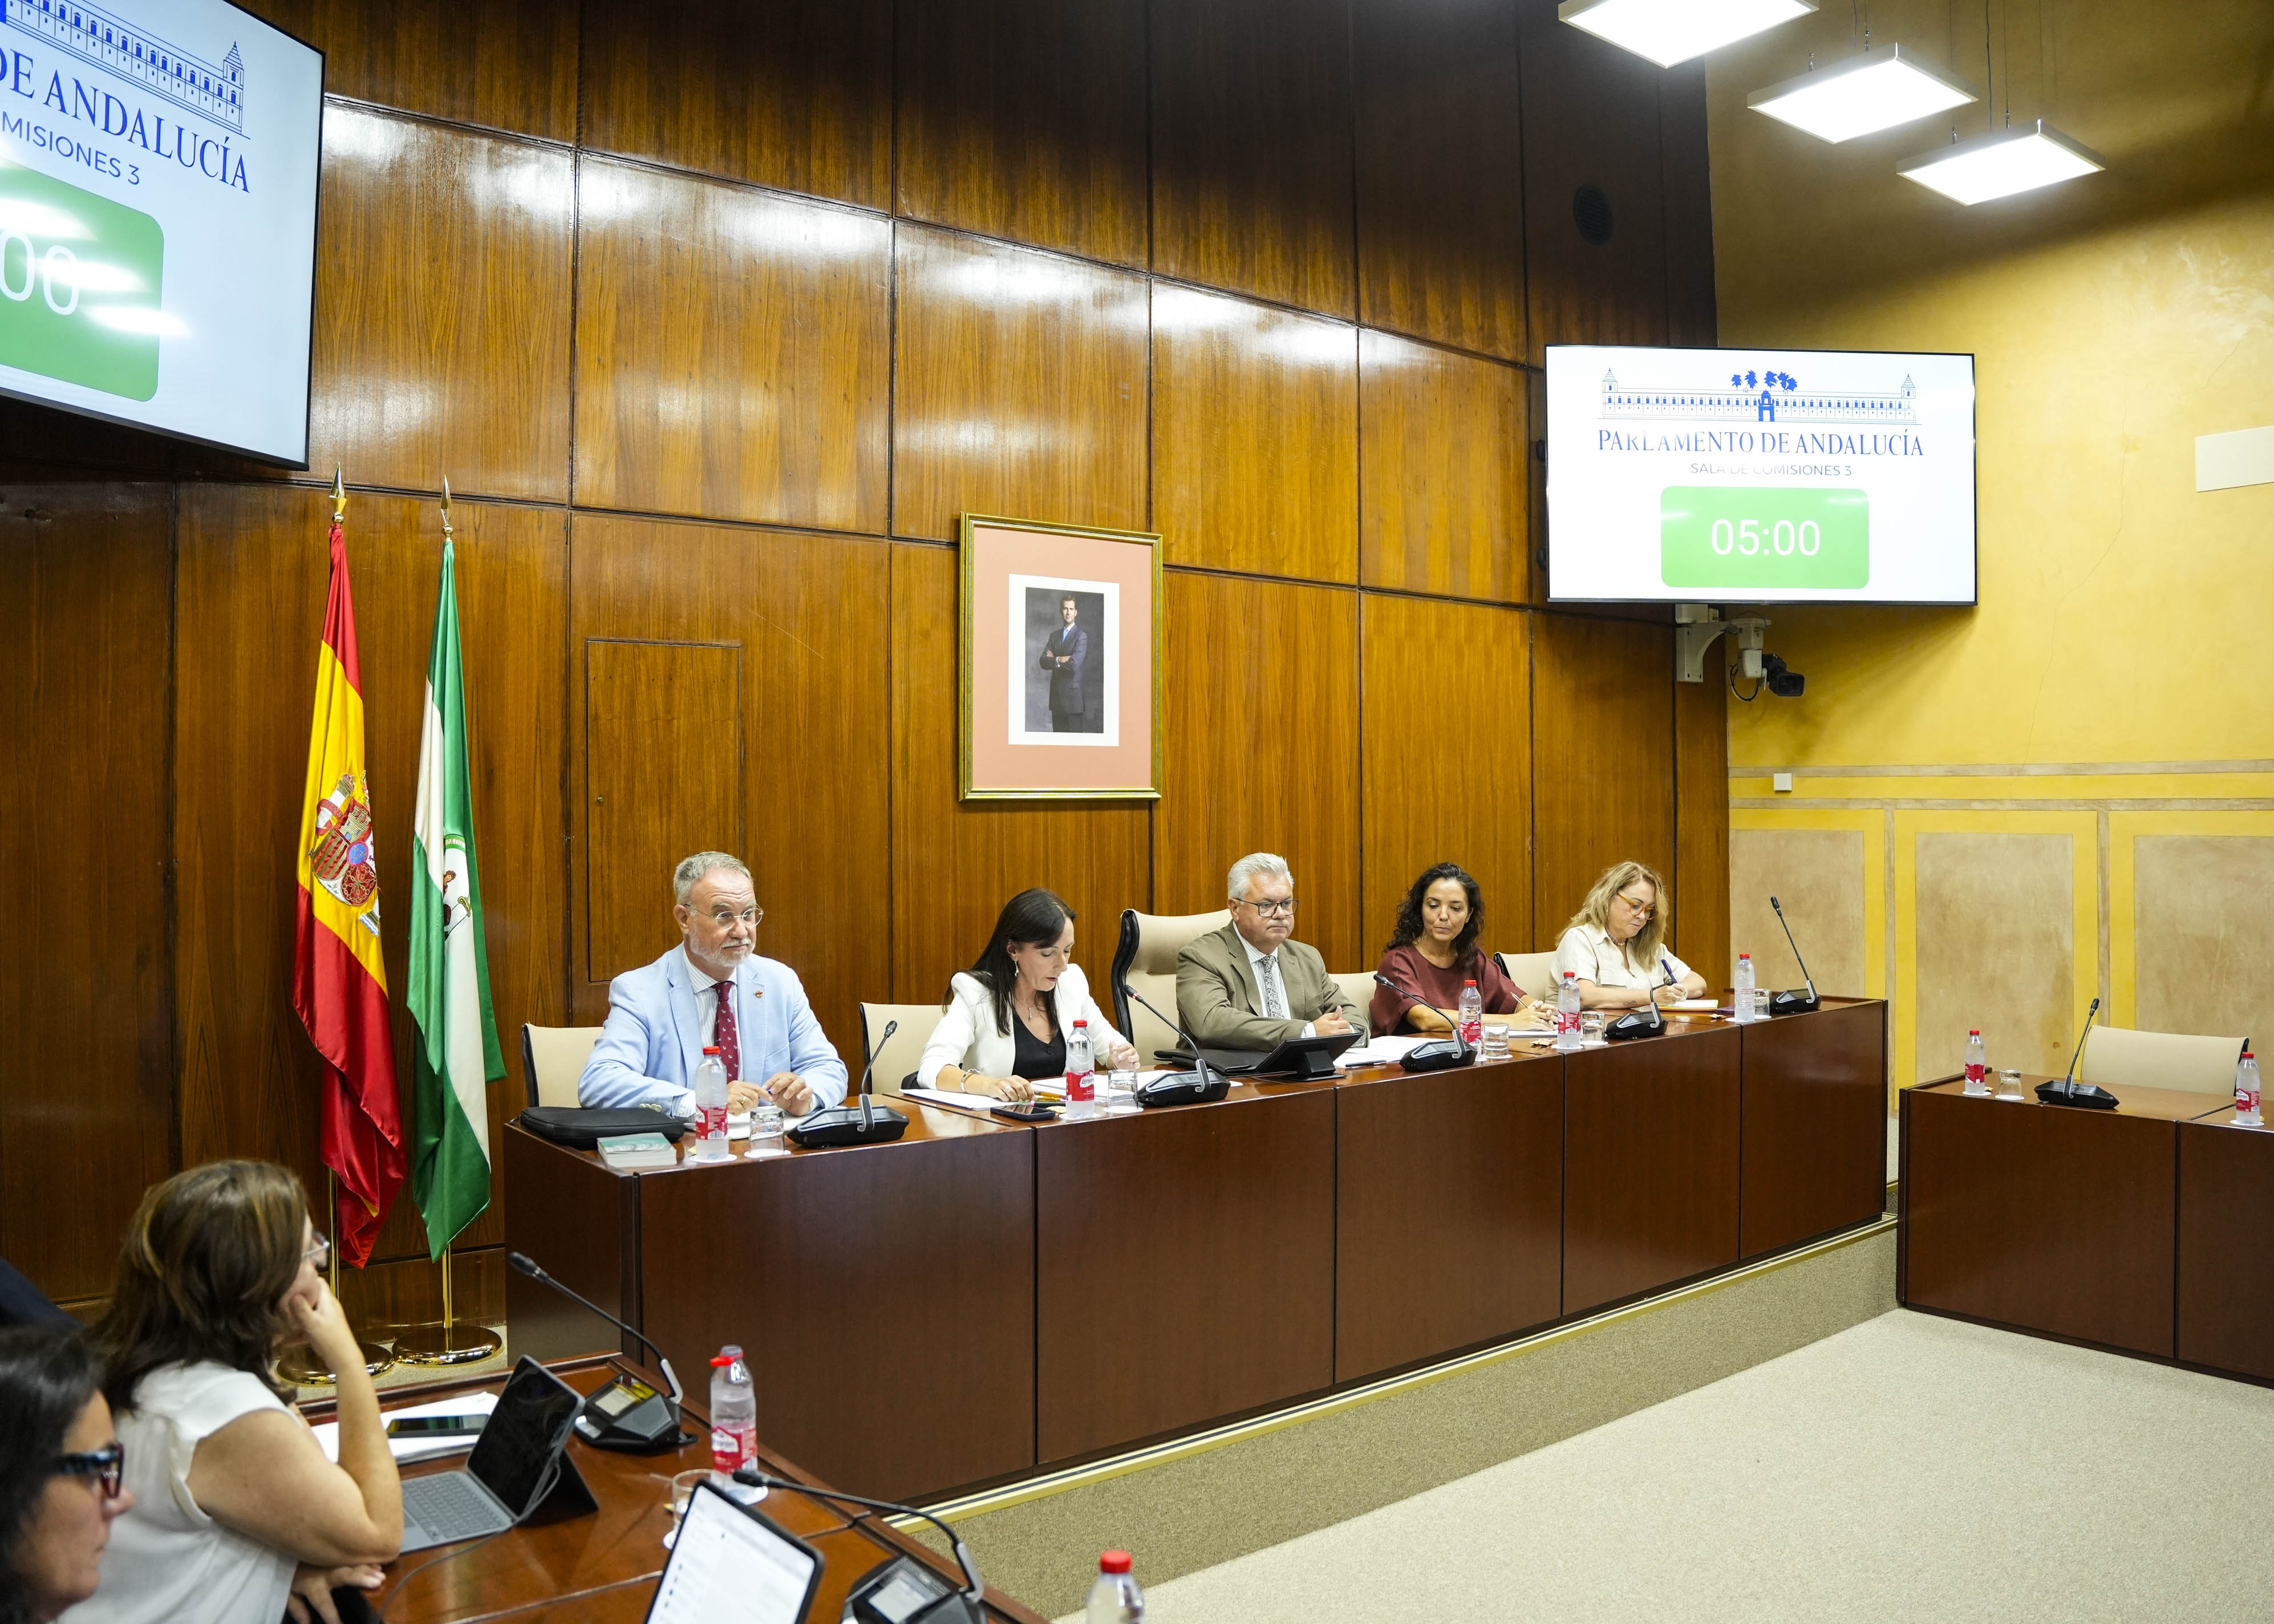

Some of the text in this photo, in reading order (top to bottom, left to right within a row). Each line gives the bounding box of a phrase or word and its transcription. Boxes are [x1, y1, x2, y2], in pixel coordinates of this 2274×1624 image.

[0, 47, 250, 193] E ANDALUCÍA
[2, 111, 140, 185] MISIONES 3
[1598, 428, 1924, 456] PARLAMENTO DE ANDALUCÍA
[1691, 462, 1725, 474] SALA
[1844, 465, 1853, 476] 3
[1711, 518, 1821, 556] 05:00
